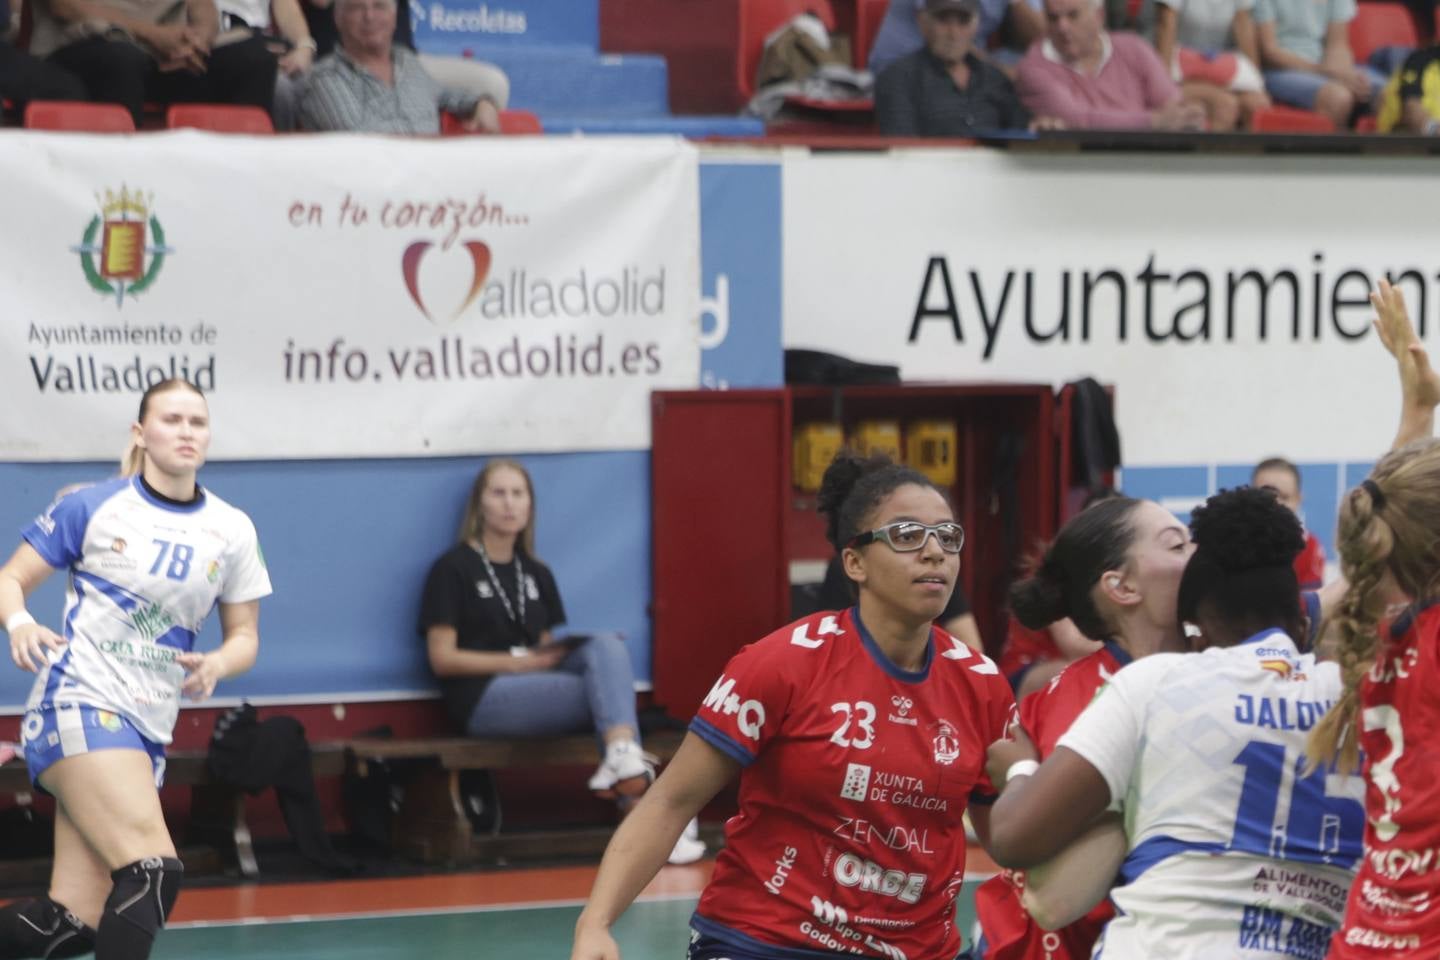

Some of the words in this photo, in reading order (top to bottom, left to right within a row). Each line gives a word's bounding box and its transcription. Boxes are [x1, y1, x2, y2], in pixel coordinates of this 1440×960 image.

[287, 199, 323, 228] en
[339, 195, 368, 226] tu
[28, 321, 183, 348] Ayuntamiento
[190, 321, 218, 346] de
[28, 353, 216, 395] Valladolid
[282, 331, 663, 384] info.valladolid.es
[150, 536, 194, 583] 78
[830, 700, 877, 750] 23
[870, 787, 889, 802] DE
[891, 791, 948, 813] GALICIA
[873, 771, 924, 794] XUNTA
[1232, 740, 1366, 872] 16
[832, 815, 935, 855] ZENDAL
[833, 850, 928, 905] ORBE
